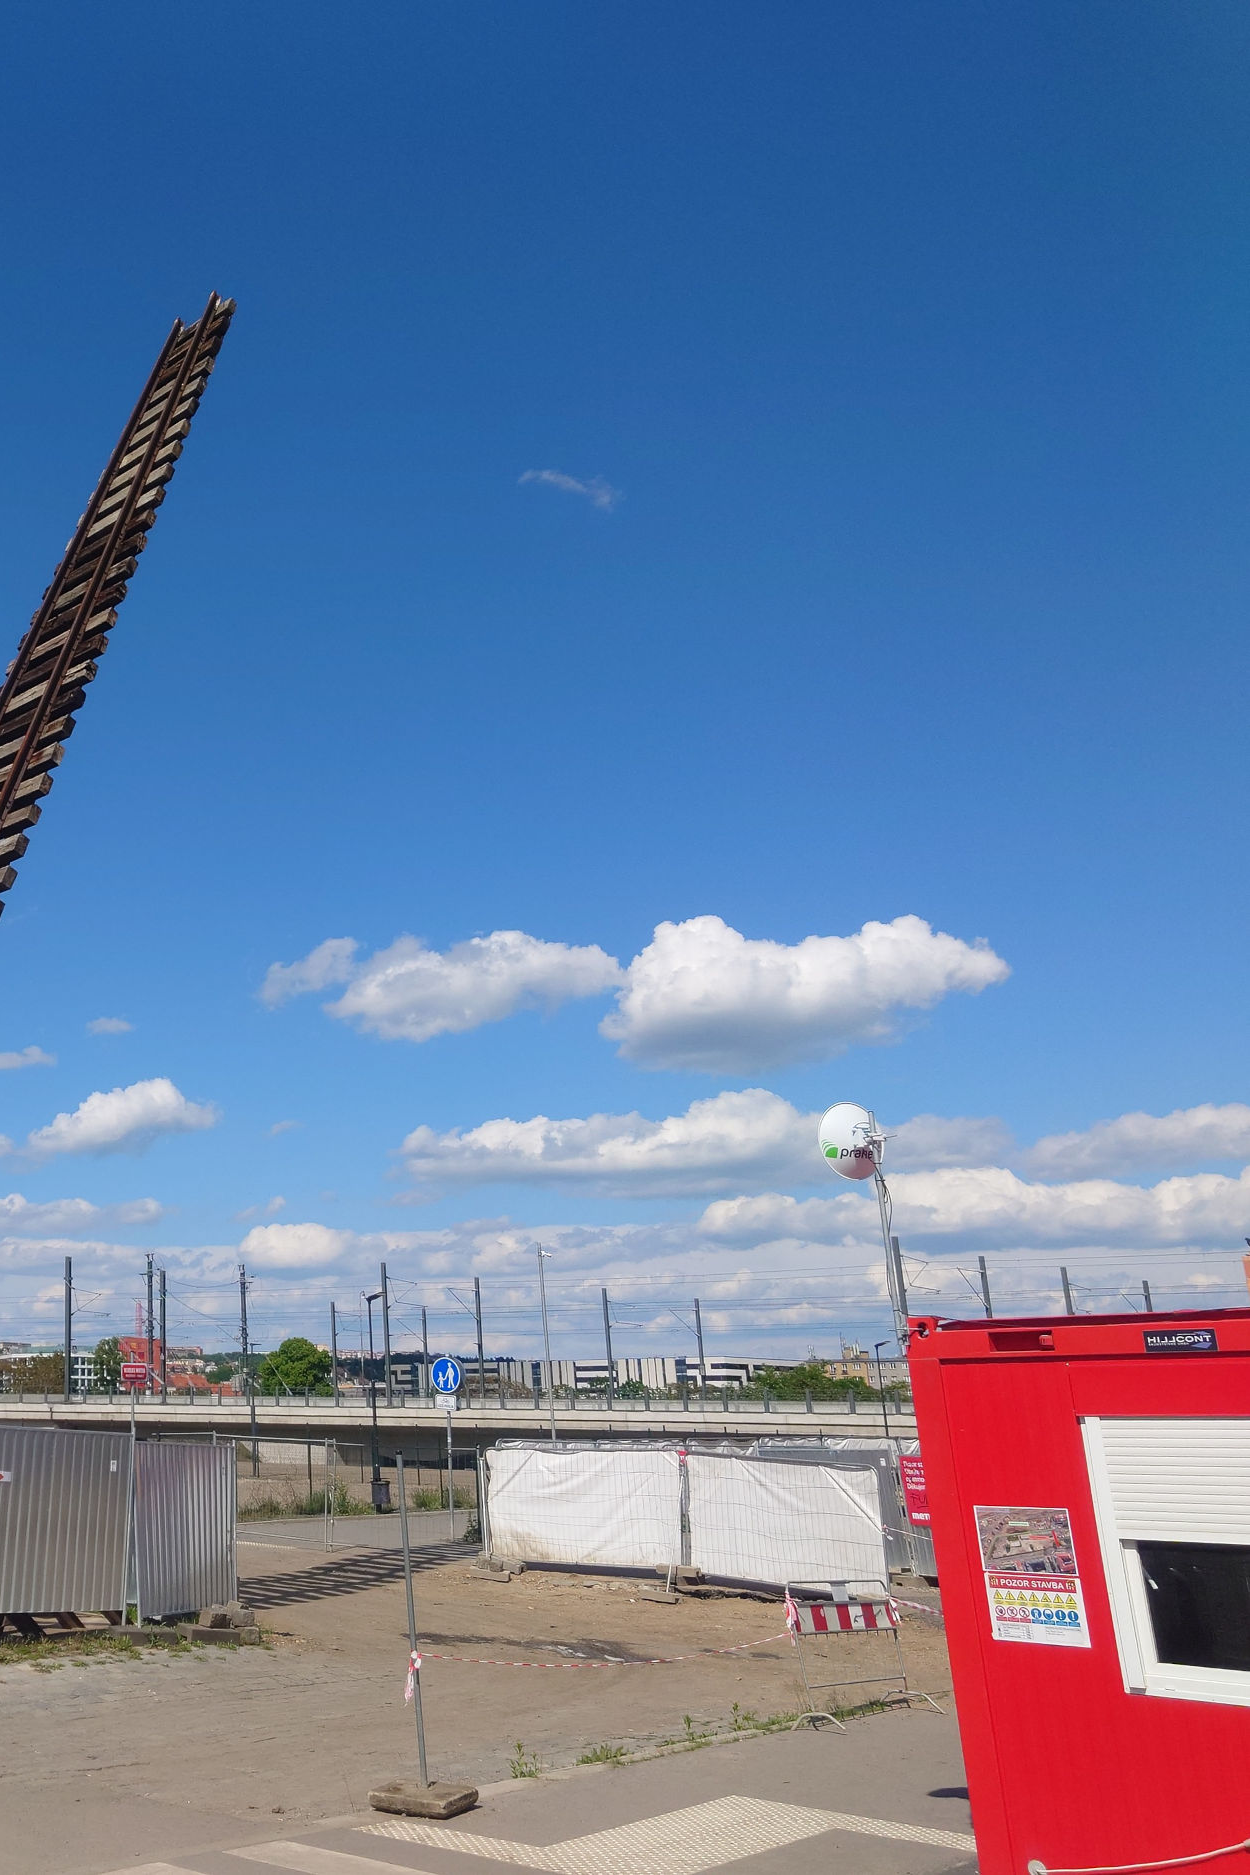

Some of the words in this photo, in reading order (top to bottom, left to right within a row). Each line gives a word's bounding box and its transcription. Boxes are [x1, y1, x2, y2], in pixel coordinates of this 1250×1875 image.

[1147, 1335, 1211, 1343] HILLCONT
[1000, 1579, 1030, 1587] POZOR
[1031, 1580, 1064, 1590] STAVBA
